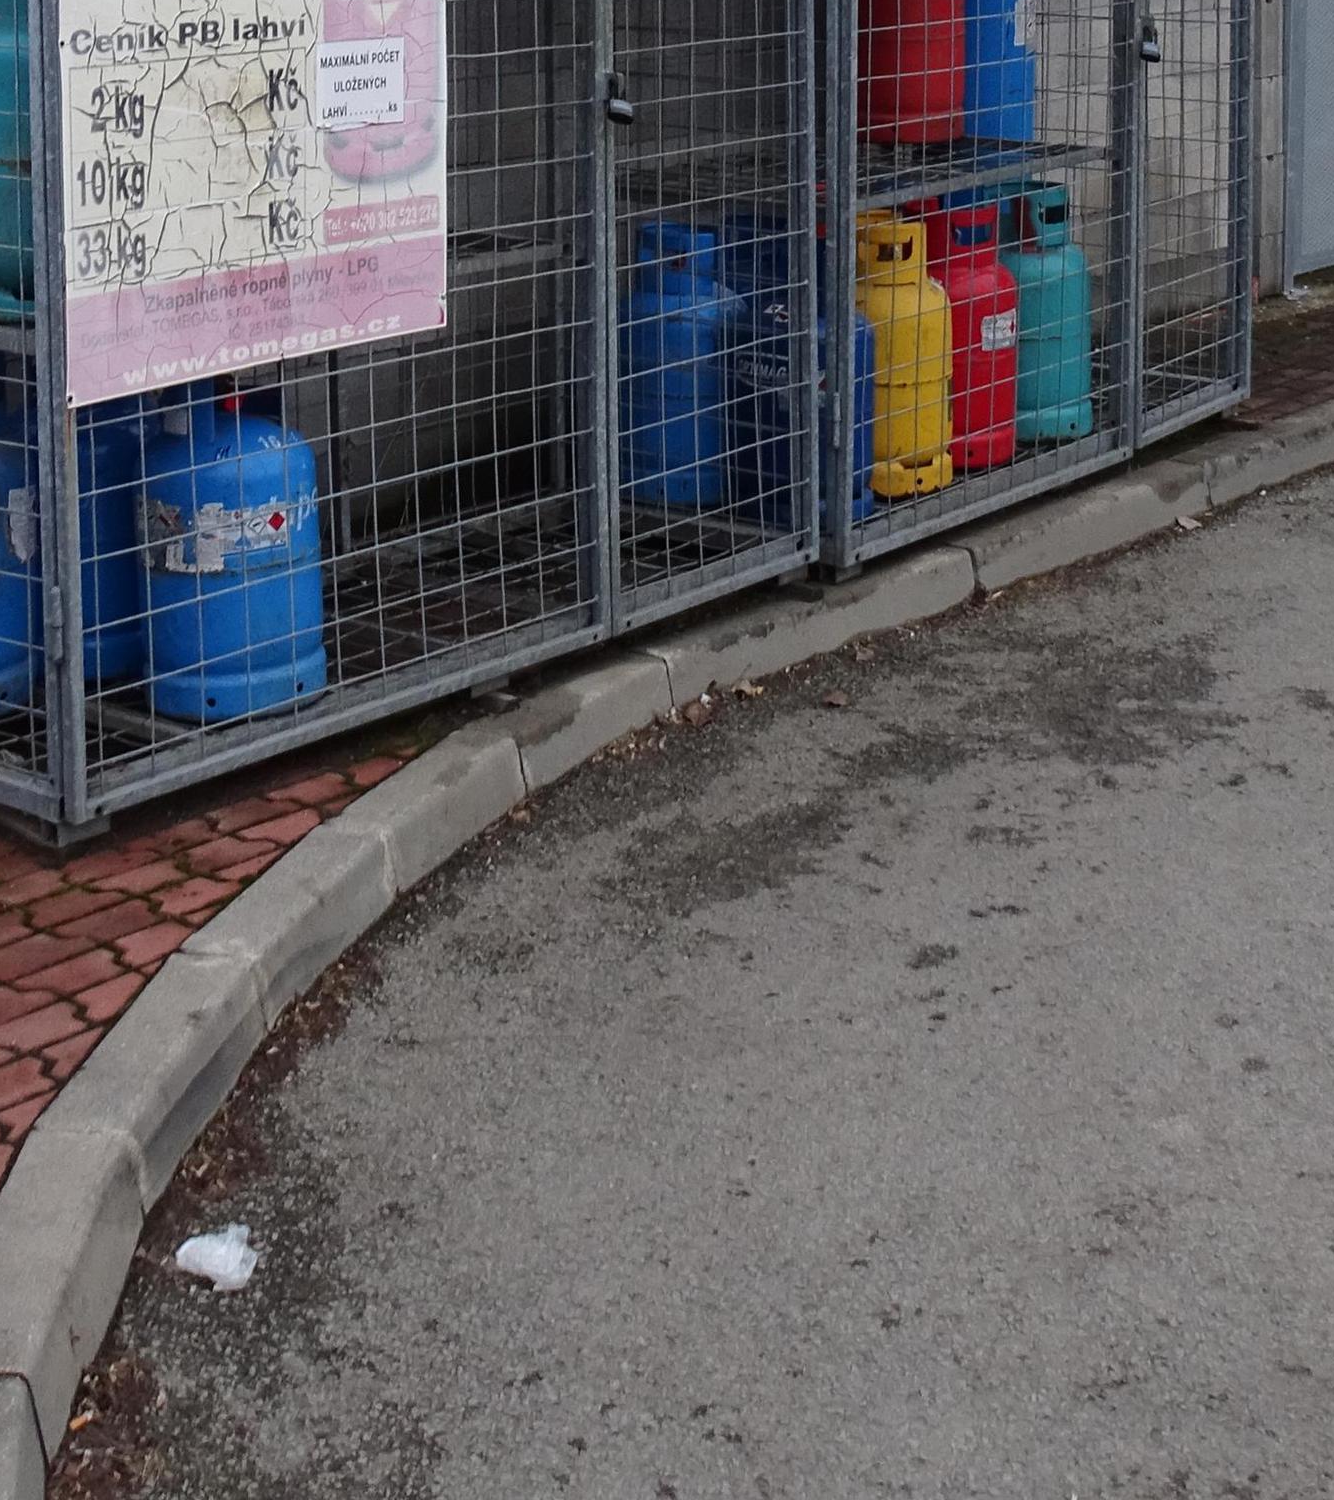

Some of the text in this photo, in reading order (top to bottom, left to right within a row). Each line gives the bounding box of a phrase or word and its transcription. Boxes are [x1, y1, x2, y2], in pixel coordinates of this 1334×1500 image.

[69, 13, 306, 56] Ceník PB lahví
[320, 46, 400, 69] MAXIMÁLNÍ POČET
[90, 67, 299, 139] 2 kg Kč
[333, 75, 387, 93] ULOŽENÝCH
[76, 135, 299, 210] 10 kg Kč
[76, 198, 300, 278] 33 kg Kč
[144, 279, 237, 314] Zkapalněné
[241, 271, 287, 297] ropné
[291, 265, 333, 292] plyny
[347, 255, 379, 277] LPG
[122, 314, 401, 386] www.tomegas.cz
